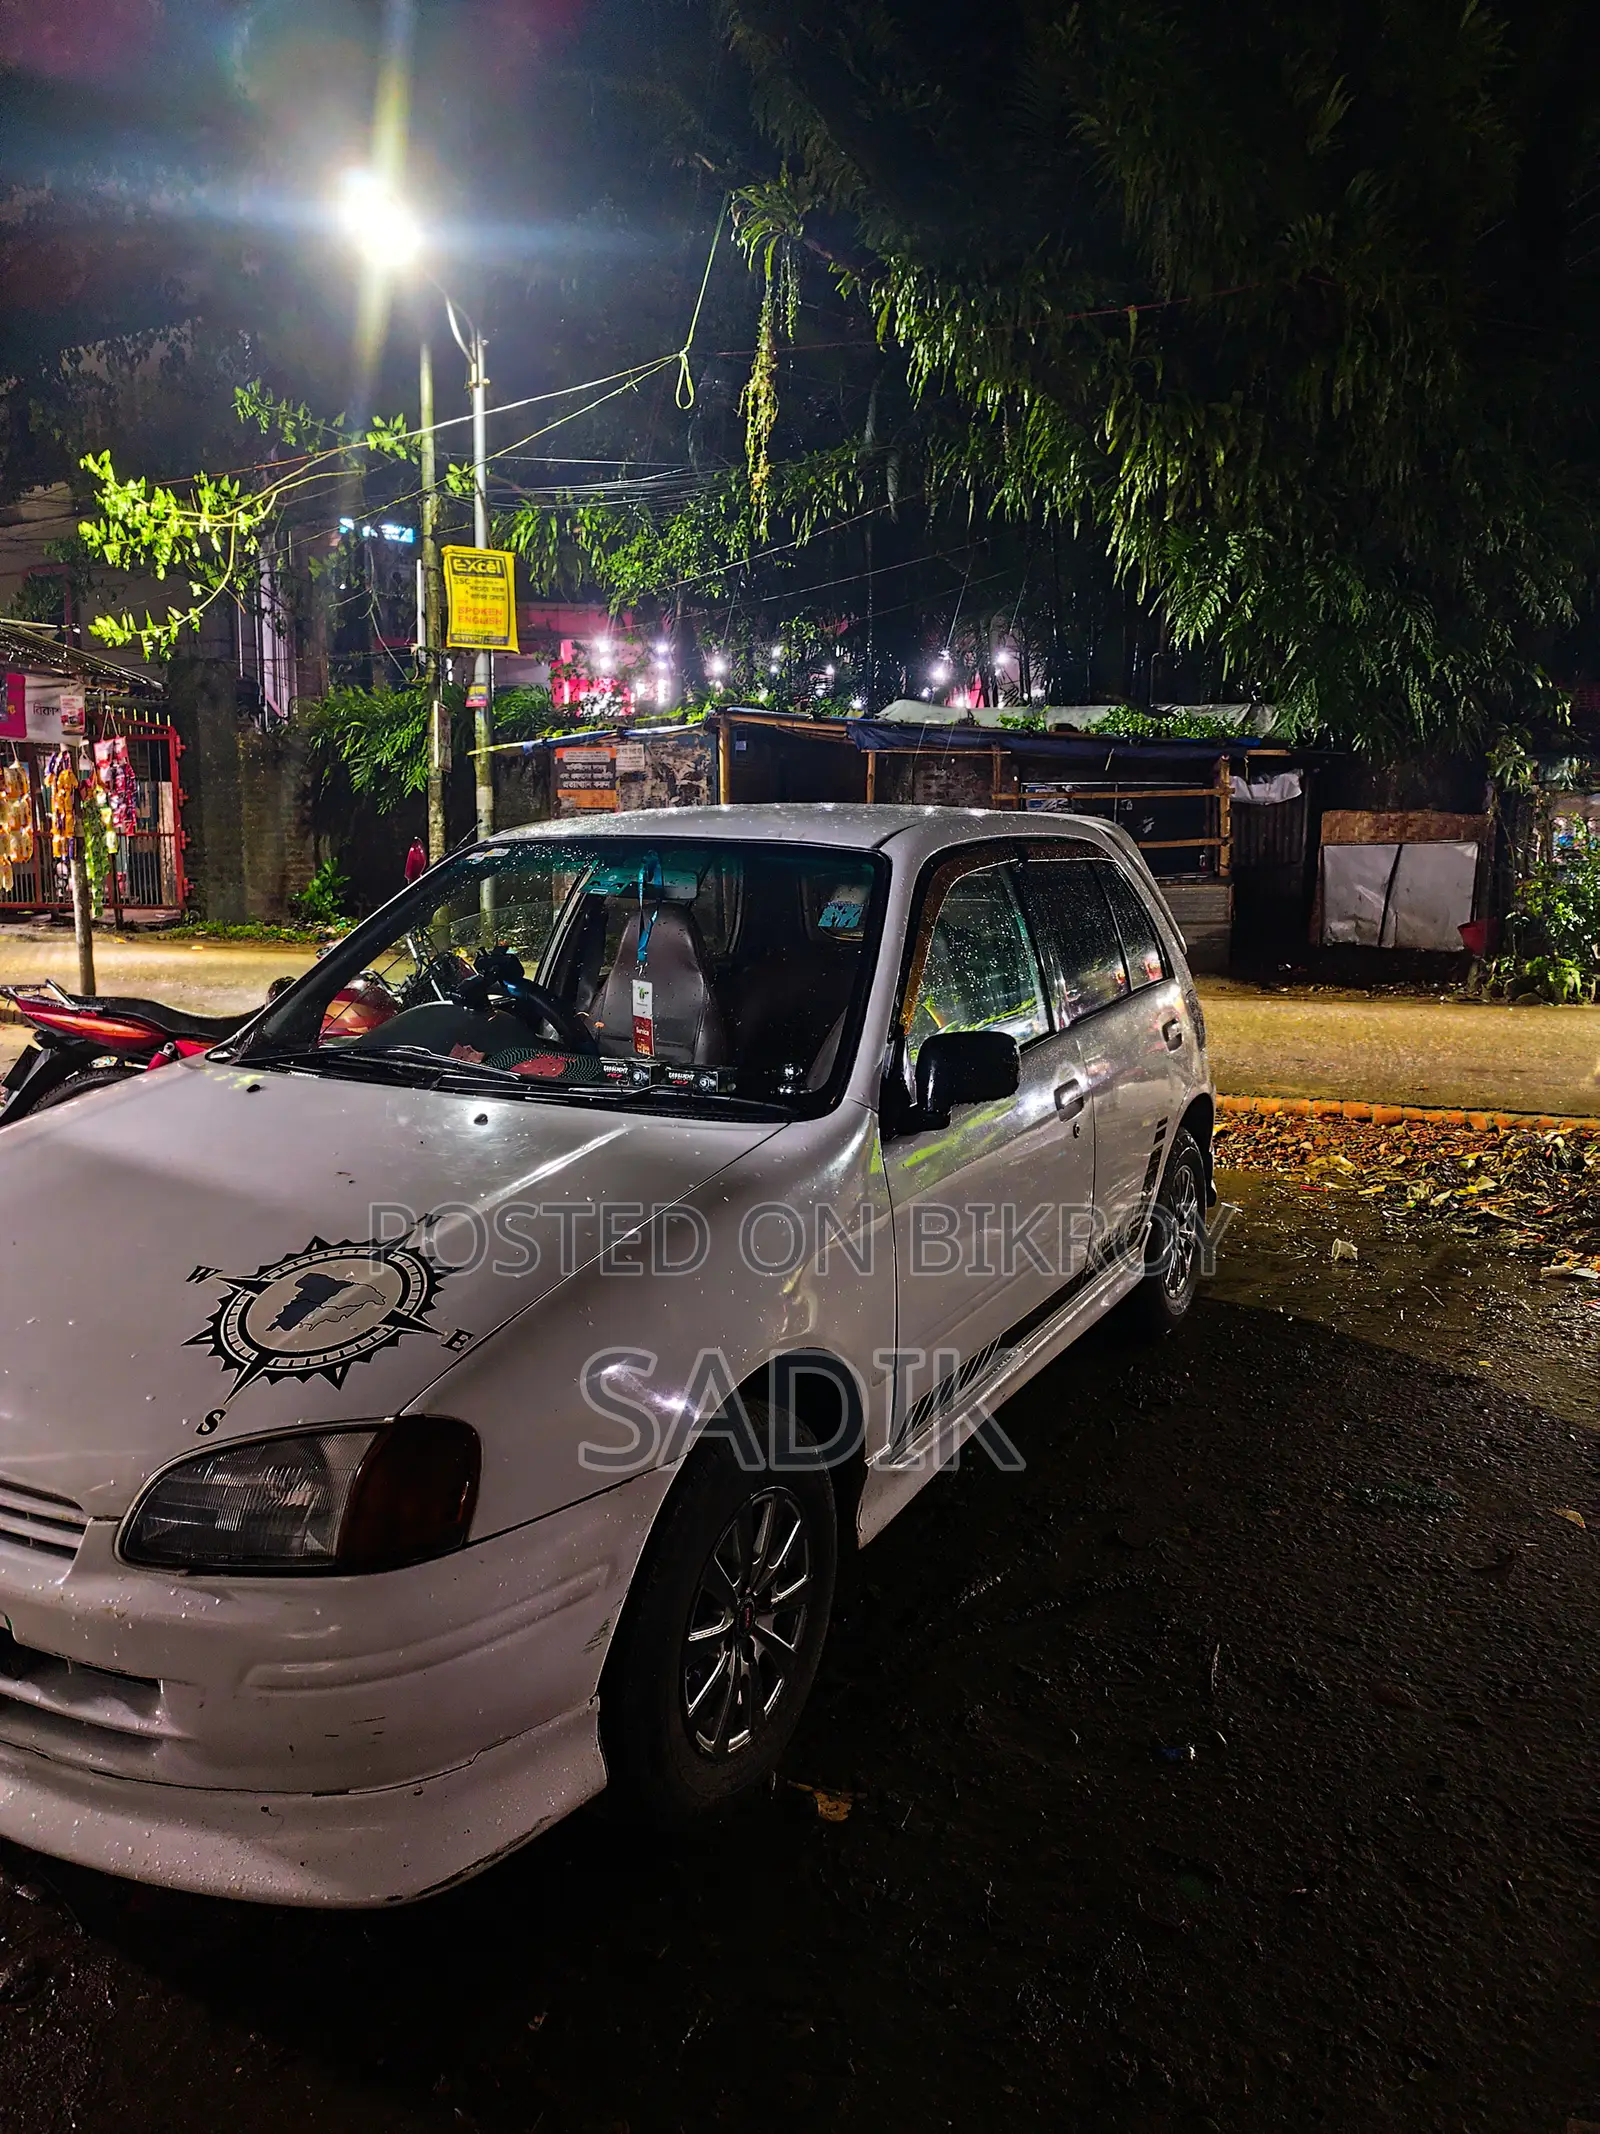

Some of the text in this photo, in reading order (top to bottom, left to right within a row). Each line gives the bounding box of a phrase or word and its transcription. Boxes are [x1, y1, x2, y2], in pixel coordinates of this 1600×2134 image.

[453, 577, 471, 585] SSC
[457, 606, 503, 616] SPOKEN
[457, 615, 503, 625] ENGLISH
[185, 1264, 223, 1284] W
[441, 1328, 475, 1352] E
[195, 1408, 227, 1436] S
